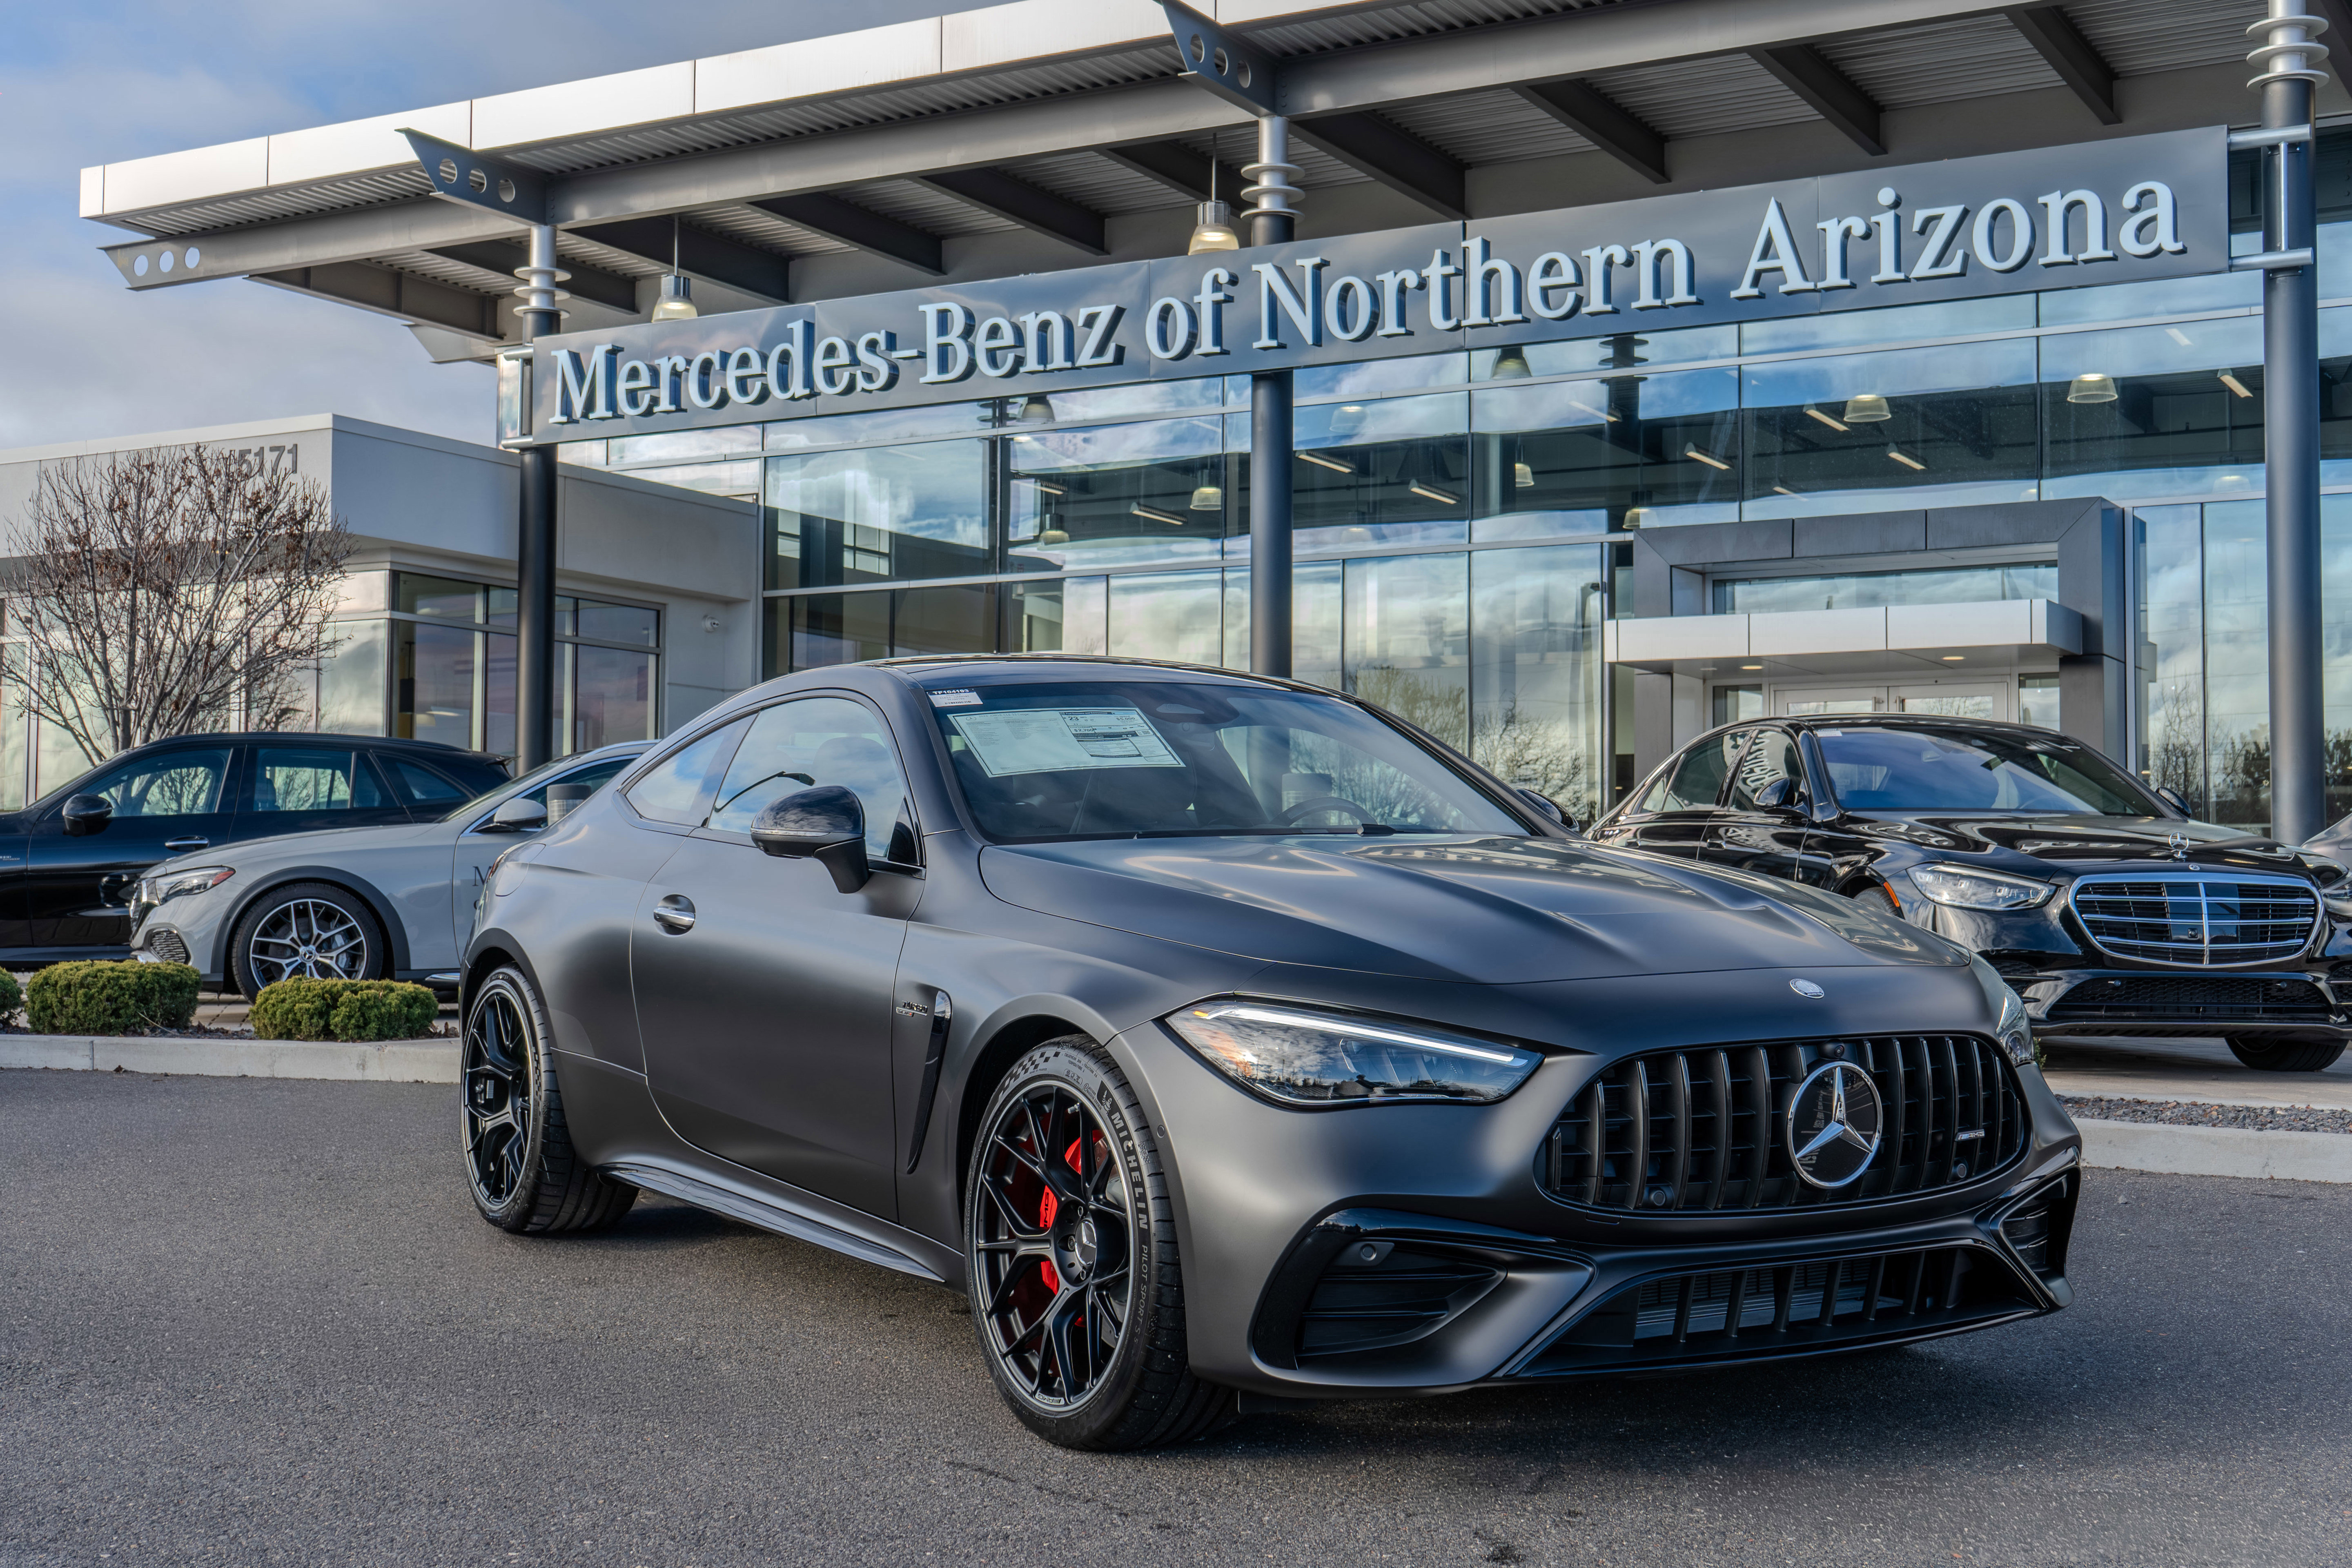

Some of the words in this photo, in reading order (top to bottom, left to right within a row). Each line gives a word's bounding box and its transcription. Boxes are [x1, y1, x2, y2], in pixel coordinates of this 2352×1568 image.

[548, 301, 1125, 425] Mercedes-Benz
[1146, 268, 1238, 361] of
[1252, 236, 1705, 350] Northern
[1731, 180, 2187, 299] Arizona
[238, 443, 298, 479] 5171
[1111, 1111, 1148, 1229] MICHELIN
[1137, 1283, 1147, 1324] SPORT
[1135, 1325, 1140, 1335] S
[1038, 1394, 1054, 1403] AMG
